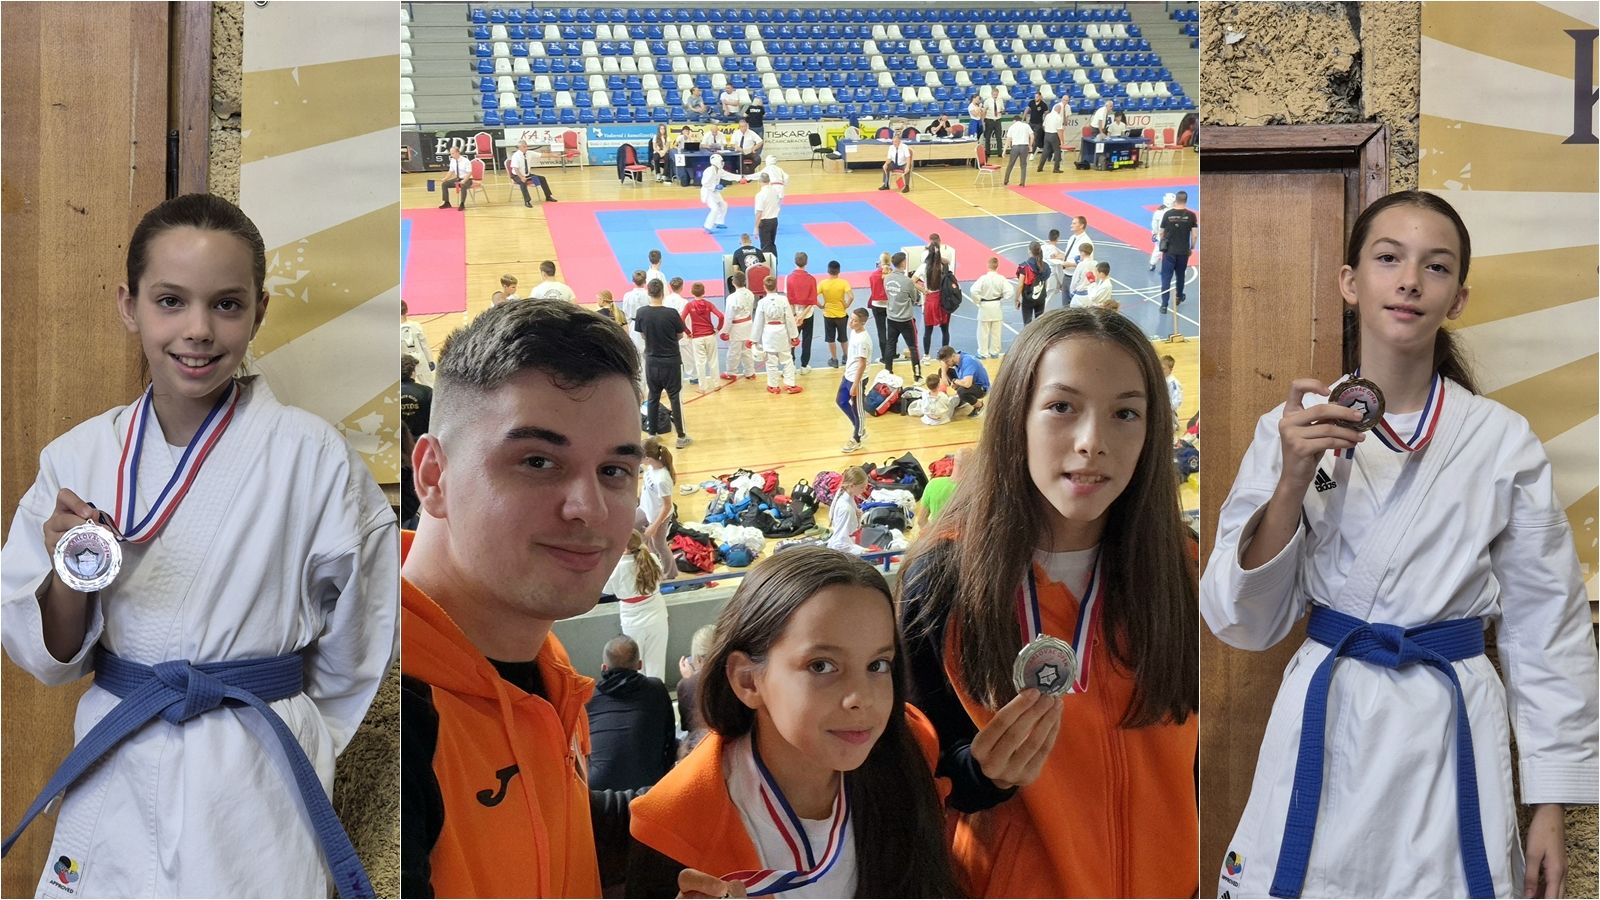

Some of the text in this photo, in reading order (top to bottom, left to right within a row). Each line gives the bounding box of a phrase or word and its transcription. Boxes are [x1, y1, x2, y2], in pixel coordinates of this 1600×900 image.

[1125, 115, 1151, 126] UTO
[765, 130, 812, 139] TISKARA
[49, 880, 74, 894] APPROVED
